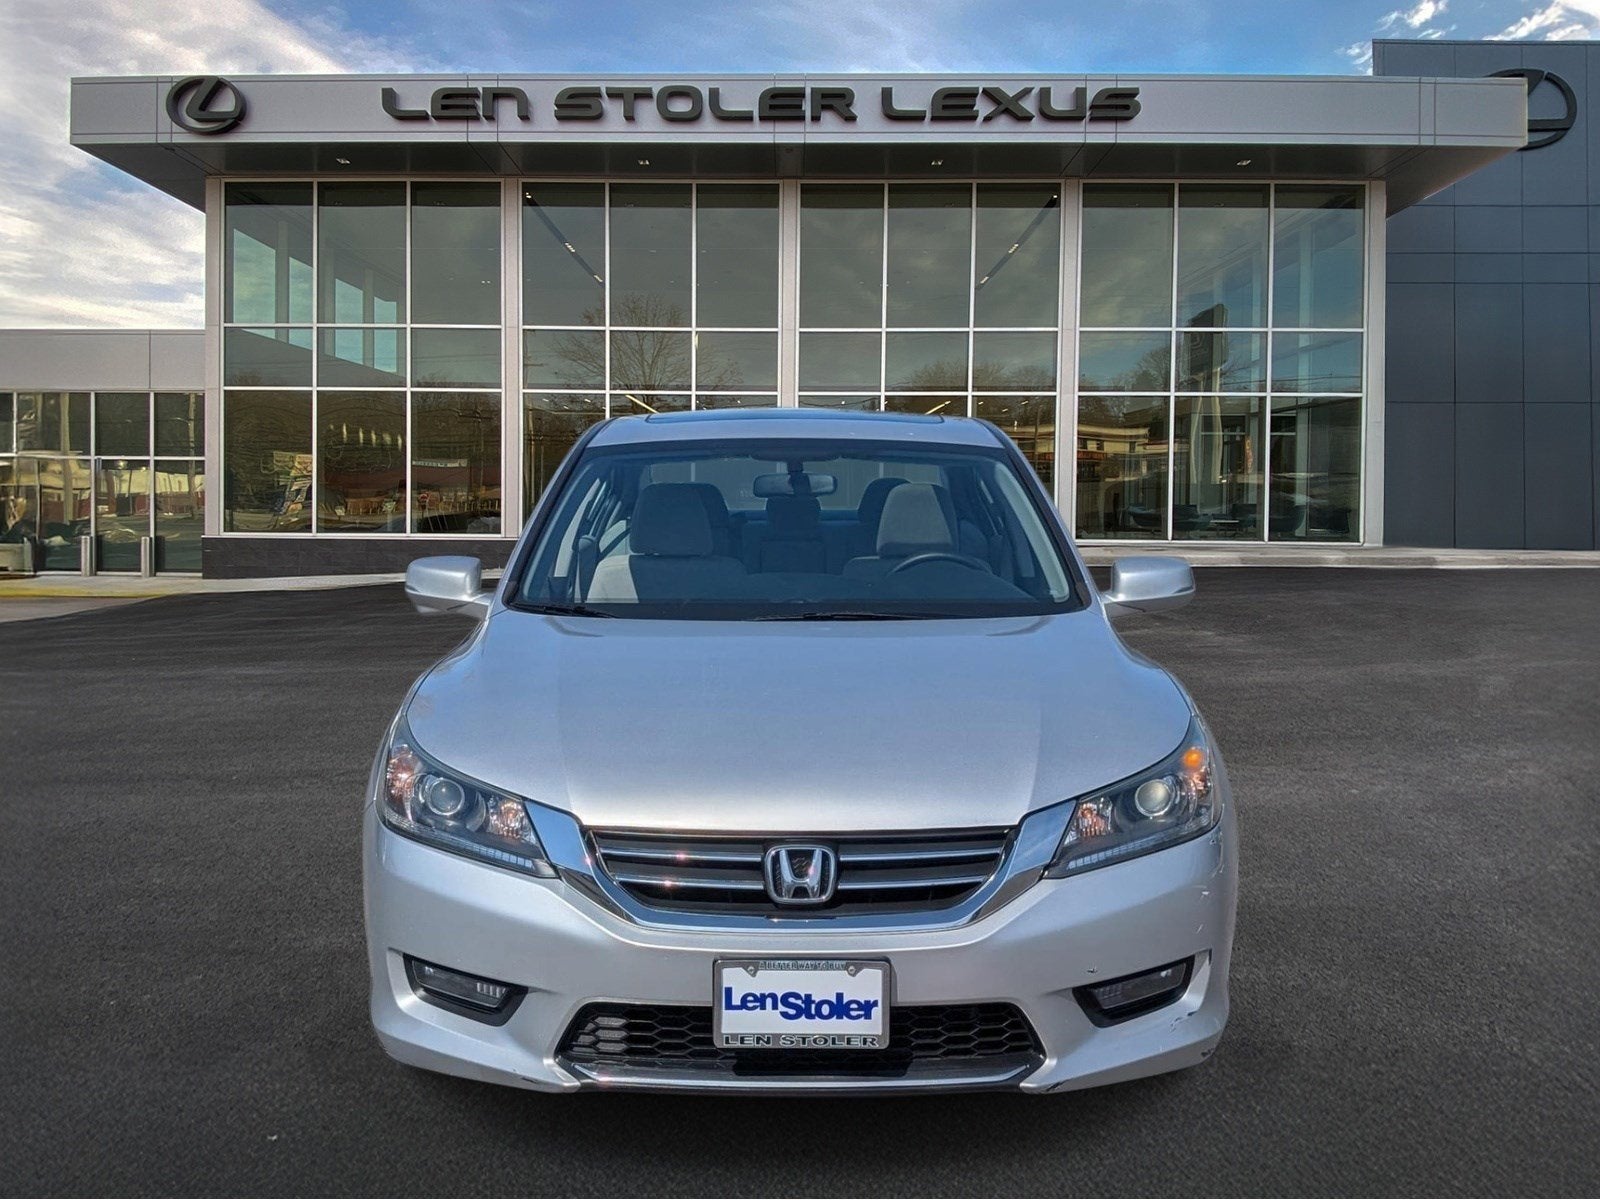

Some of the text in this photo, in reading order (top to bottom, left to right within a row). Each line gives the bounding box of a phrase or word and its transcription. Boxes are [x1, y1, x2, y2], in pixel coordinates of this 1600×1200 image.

[381, 86, 1142, 122] LEN STOLER LEXUS
[723, 1034, 879, 1047] LEN STOLER
